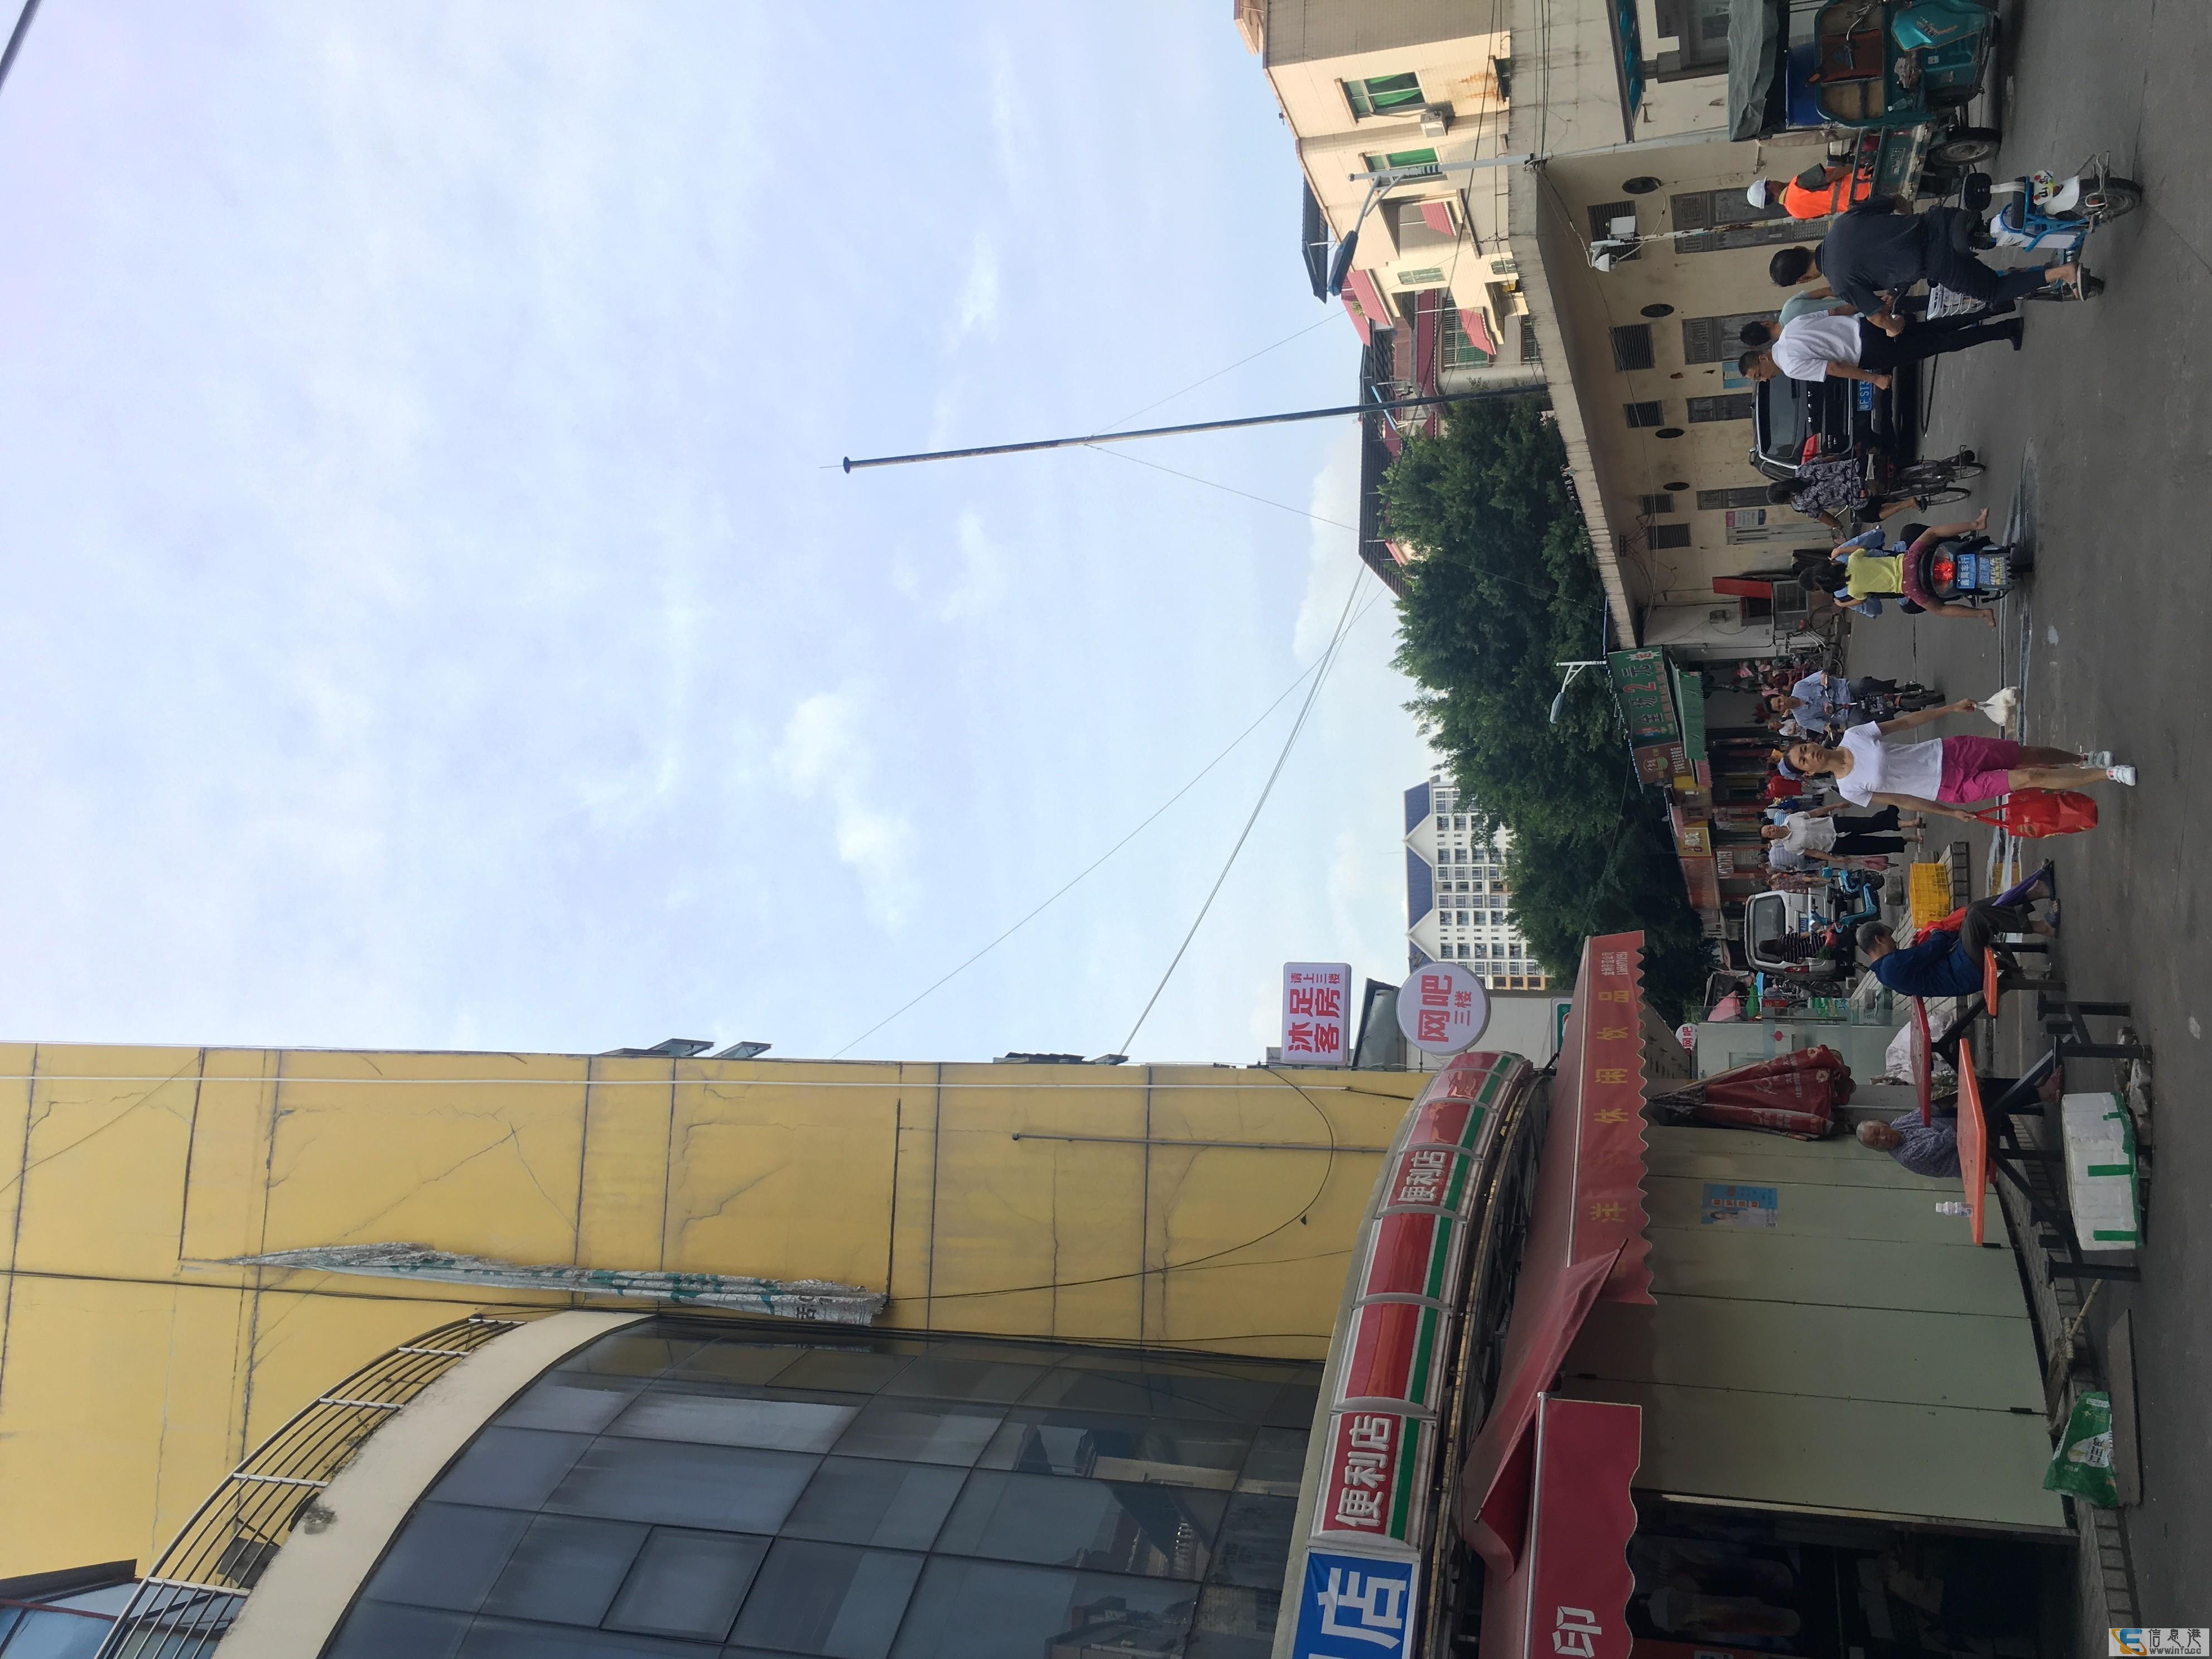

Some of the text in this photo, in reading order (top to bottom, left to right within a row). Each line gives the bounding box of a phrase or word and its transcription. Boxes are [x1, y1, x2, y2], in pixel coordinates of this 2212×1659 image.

[1290, 973, 1340, 984] 请上三楼
[1418, 975, 1453, 1043] 网吧
[1454, 991, 1472, 1026] 三楼
[1288, 987, 1313, 1053] 沐足
[1315, 988, 1341, 1053] 客房
[1682, 1026, 1693, 1047] 网吧
[1593, 990, 1630, 1124] 休闲饮品
[1397, 1151, 1447, 1202] 便利店
[1335, 1415, 1391, 1526] 便利店
[1309, 1567, 1406, 1659] 店
[1552, 1606, 1602, 1658] 印
